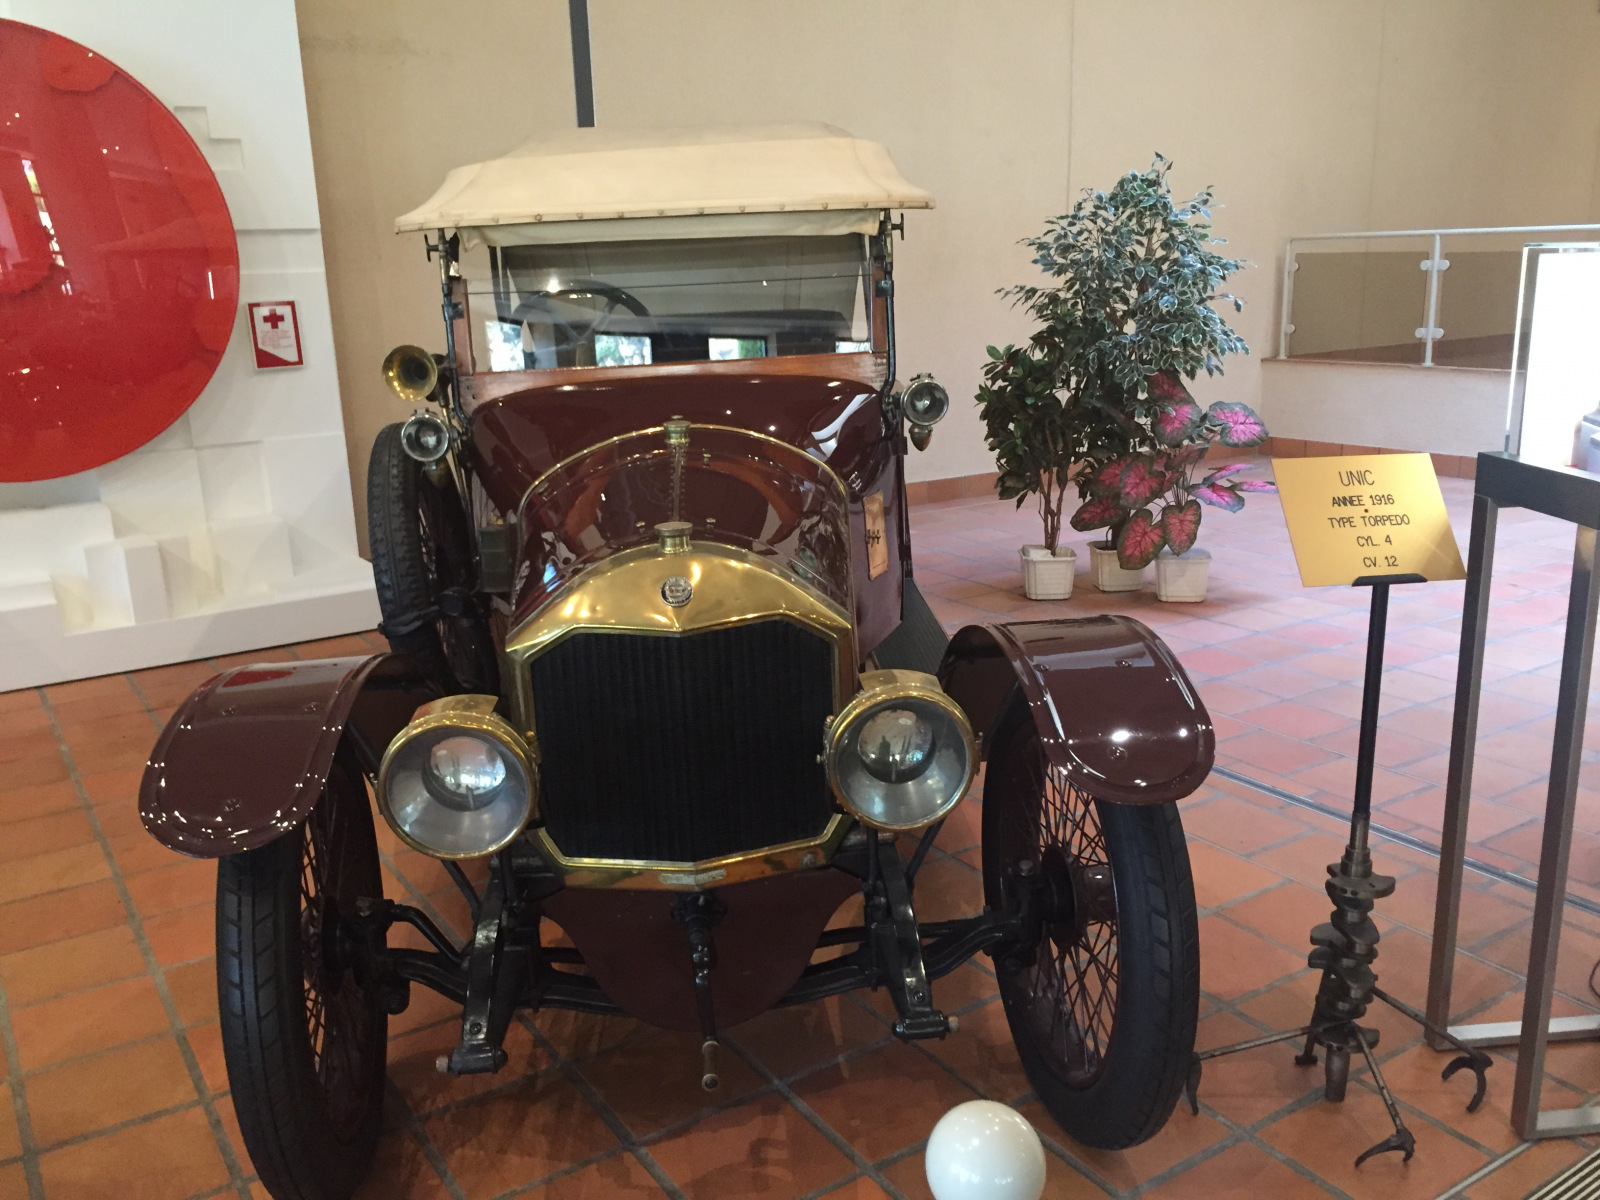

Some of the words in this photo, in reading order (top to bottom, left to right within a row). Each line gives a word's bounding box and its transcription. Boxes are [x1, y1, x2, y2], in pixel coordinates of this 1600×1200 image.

[1338, 469, 1375, 487] UNIC
[1331, 495, 1365, 508] ANNEE
[1369, 494, 1395, 506] 1916
[1327, 516, 1357, 528] TYPE
[1361, 514, 1411, 528] TORPEDO
[1356, 535, 1381, 547] CYL.
[1384, 534, 1393, 546] 4
[1362, 556, 1381, 568] CV.
[1384, 555, 1399, 567] 12
